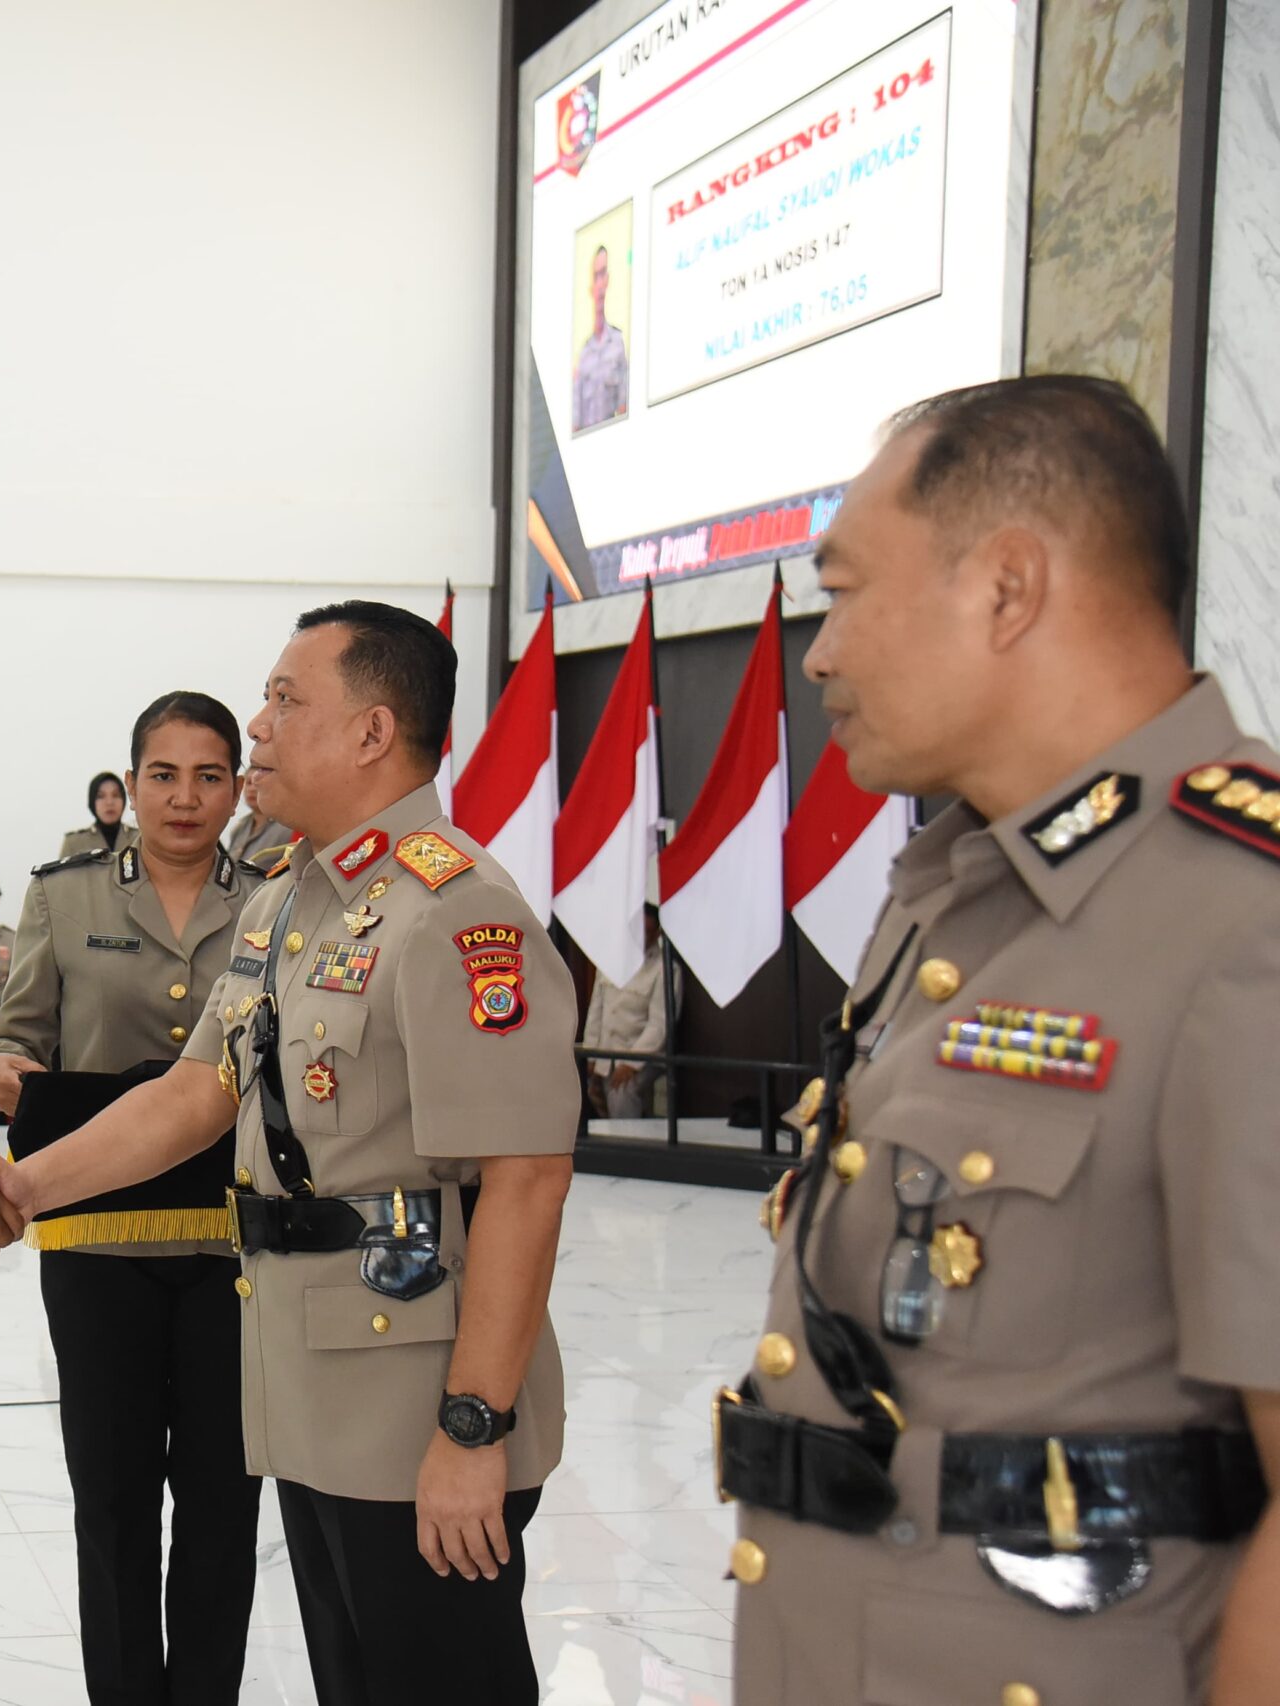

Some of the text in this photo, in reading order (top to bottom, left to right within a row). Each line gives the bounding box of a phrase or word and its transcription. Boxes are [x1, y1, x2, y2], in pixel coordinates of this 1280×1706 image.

[619, 4, 688, 77] URUTAN
[666, 110, 841, 225] RANGKING
[873, 57, 934, 112] 104
[674, 125, 922, 269] ALIF NAUFAL SYAUQI WOKAS
[722, 223, 850, 299] TON 1A NOSIS 147
[705, 325, 746, 359] NILAI
[752, 302, 802, 341] AKHIR
[821, 274, 868, 316] 76,05
[235, 959, 259, 971] LATIF
[461, 927, 517, 949] POLDA
[469, 954, 517, 969] MALUKU
